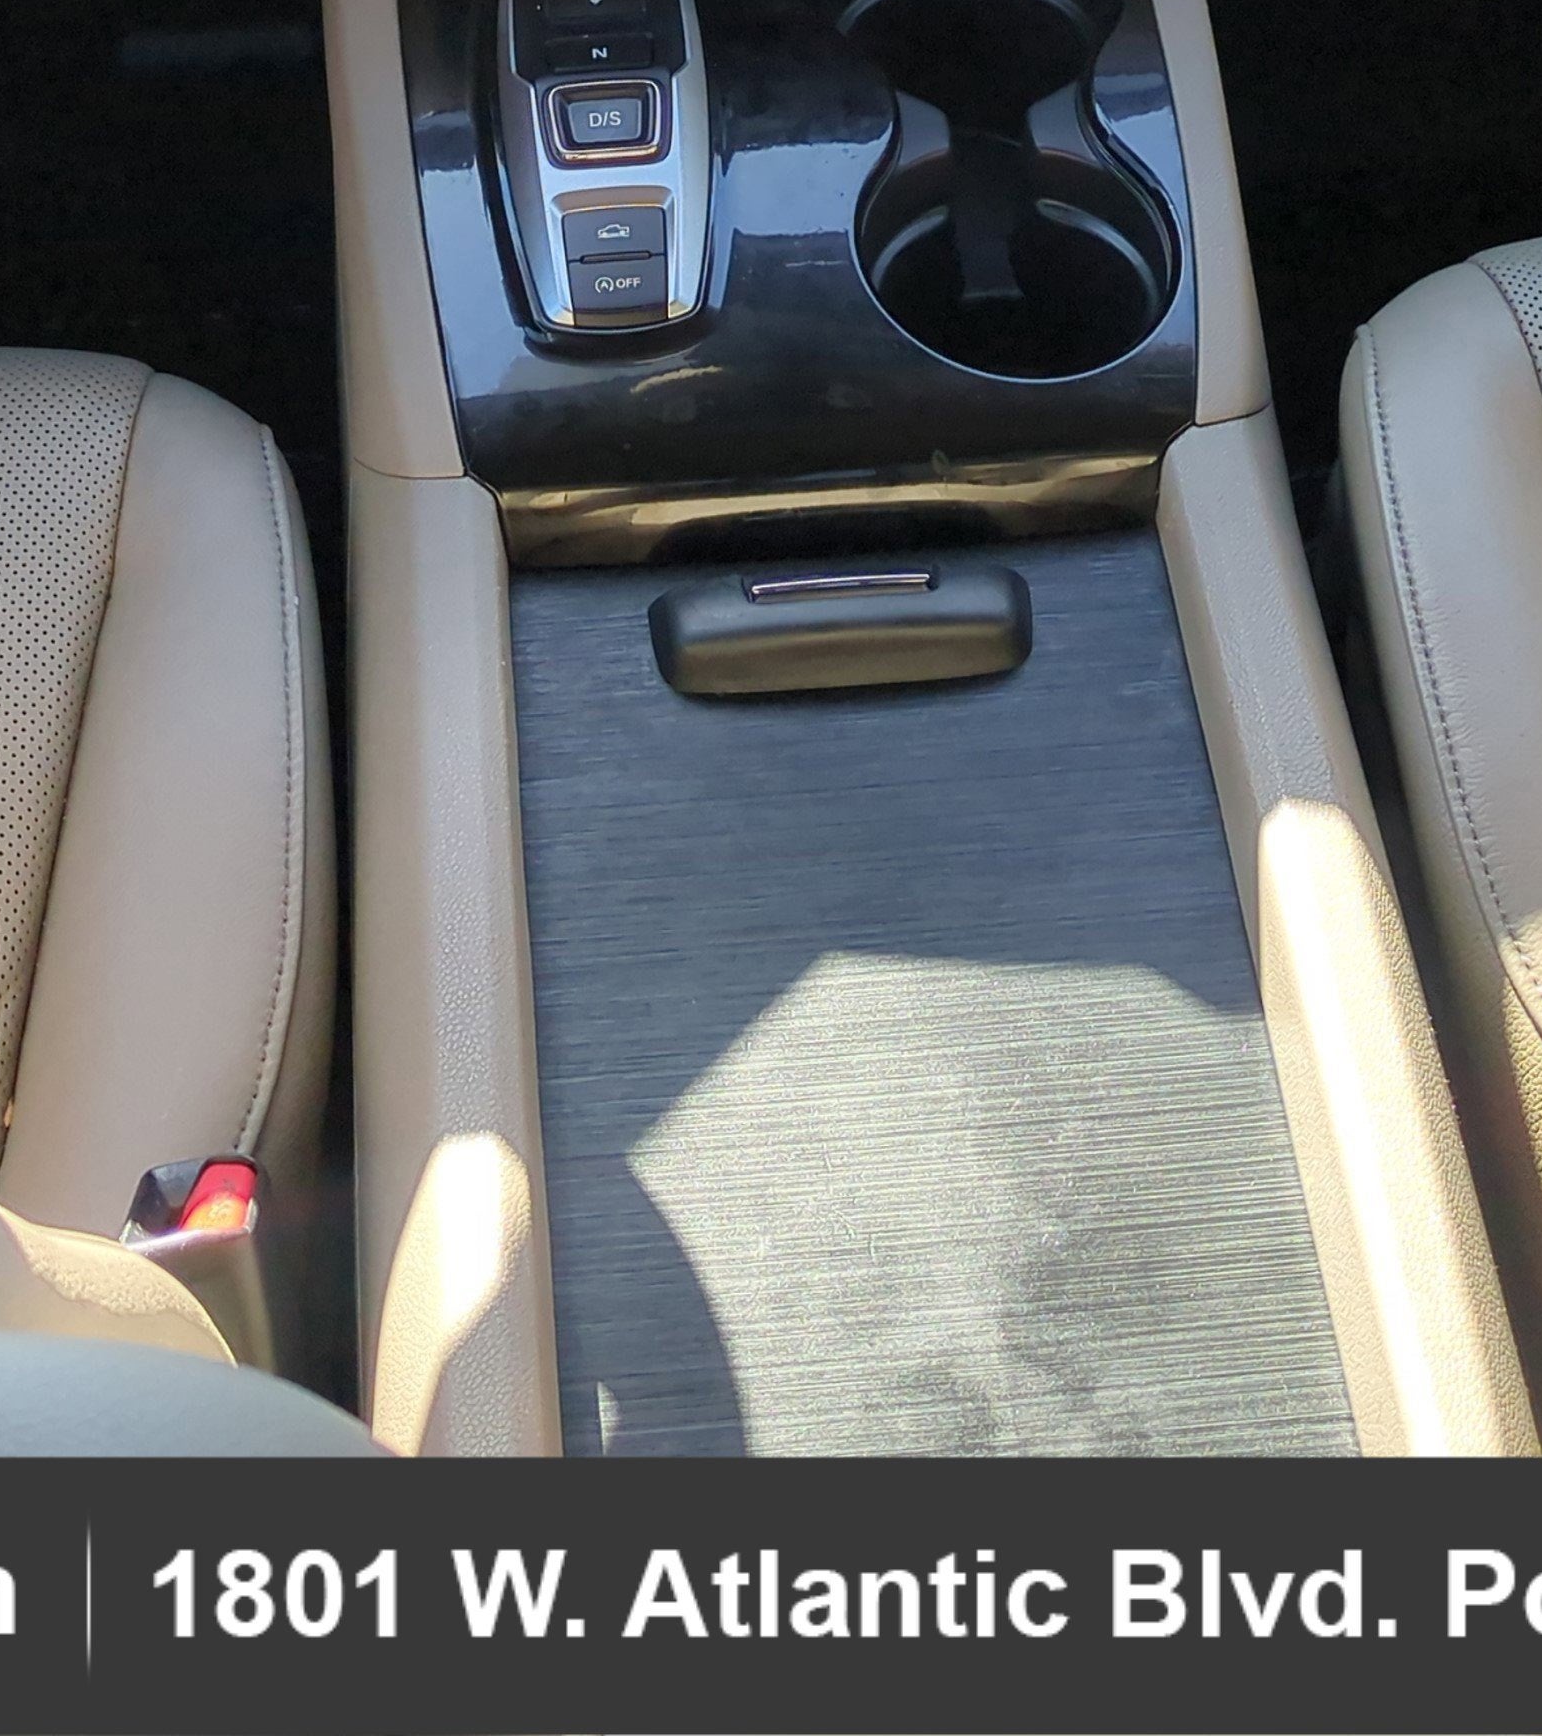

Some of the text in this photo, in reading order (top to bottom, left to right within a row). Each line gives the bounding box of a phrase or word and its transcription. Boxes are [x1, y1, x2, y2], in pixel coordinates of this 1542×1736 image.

[591, 47, 607, 59] N
[589, 111, 622, 128] D/S
[616, 276, 641, 289] OFF
